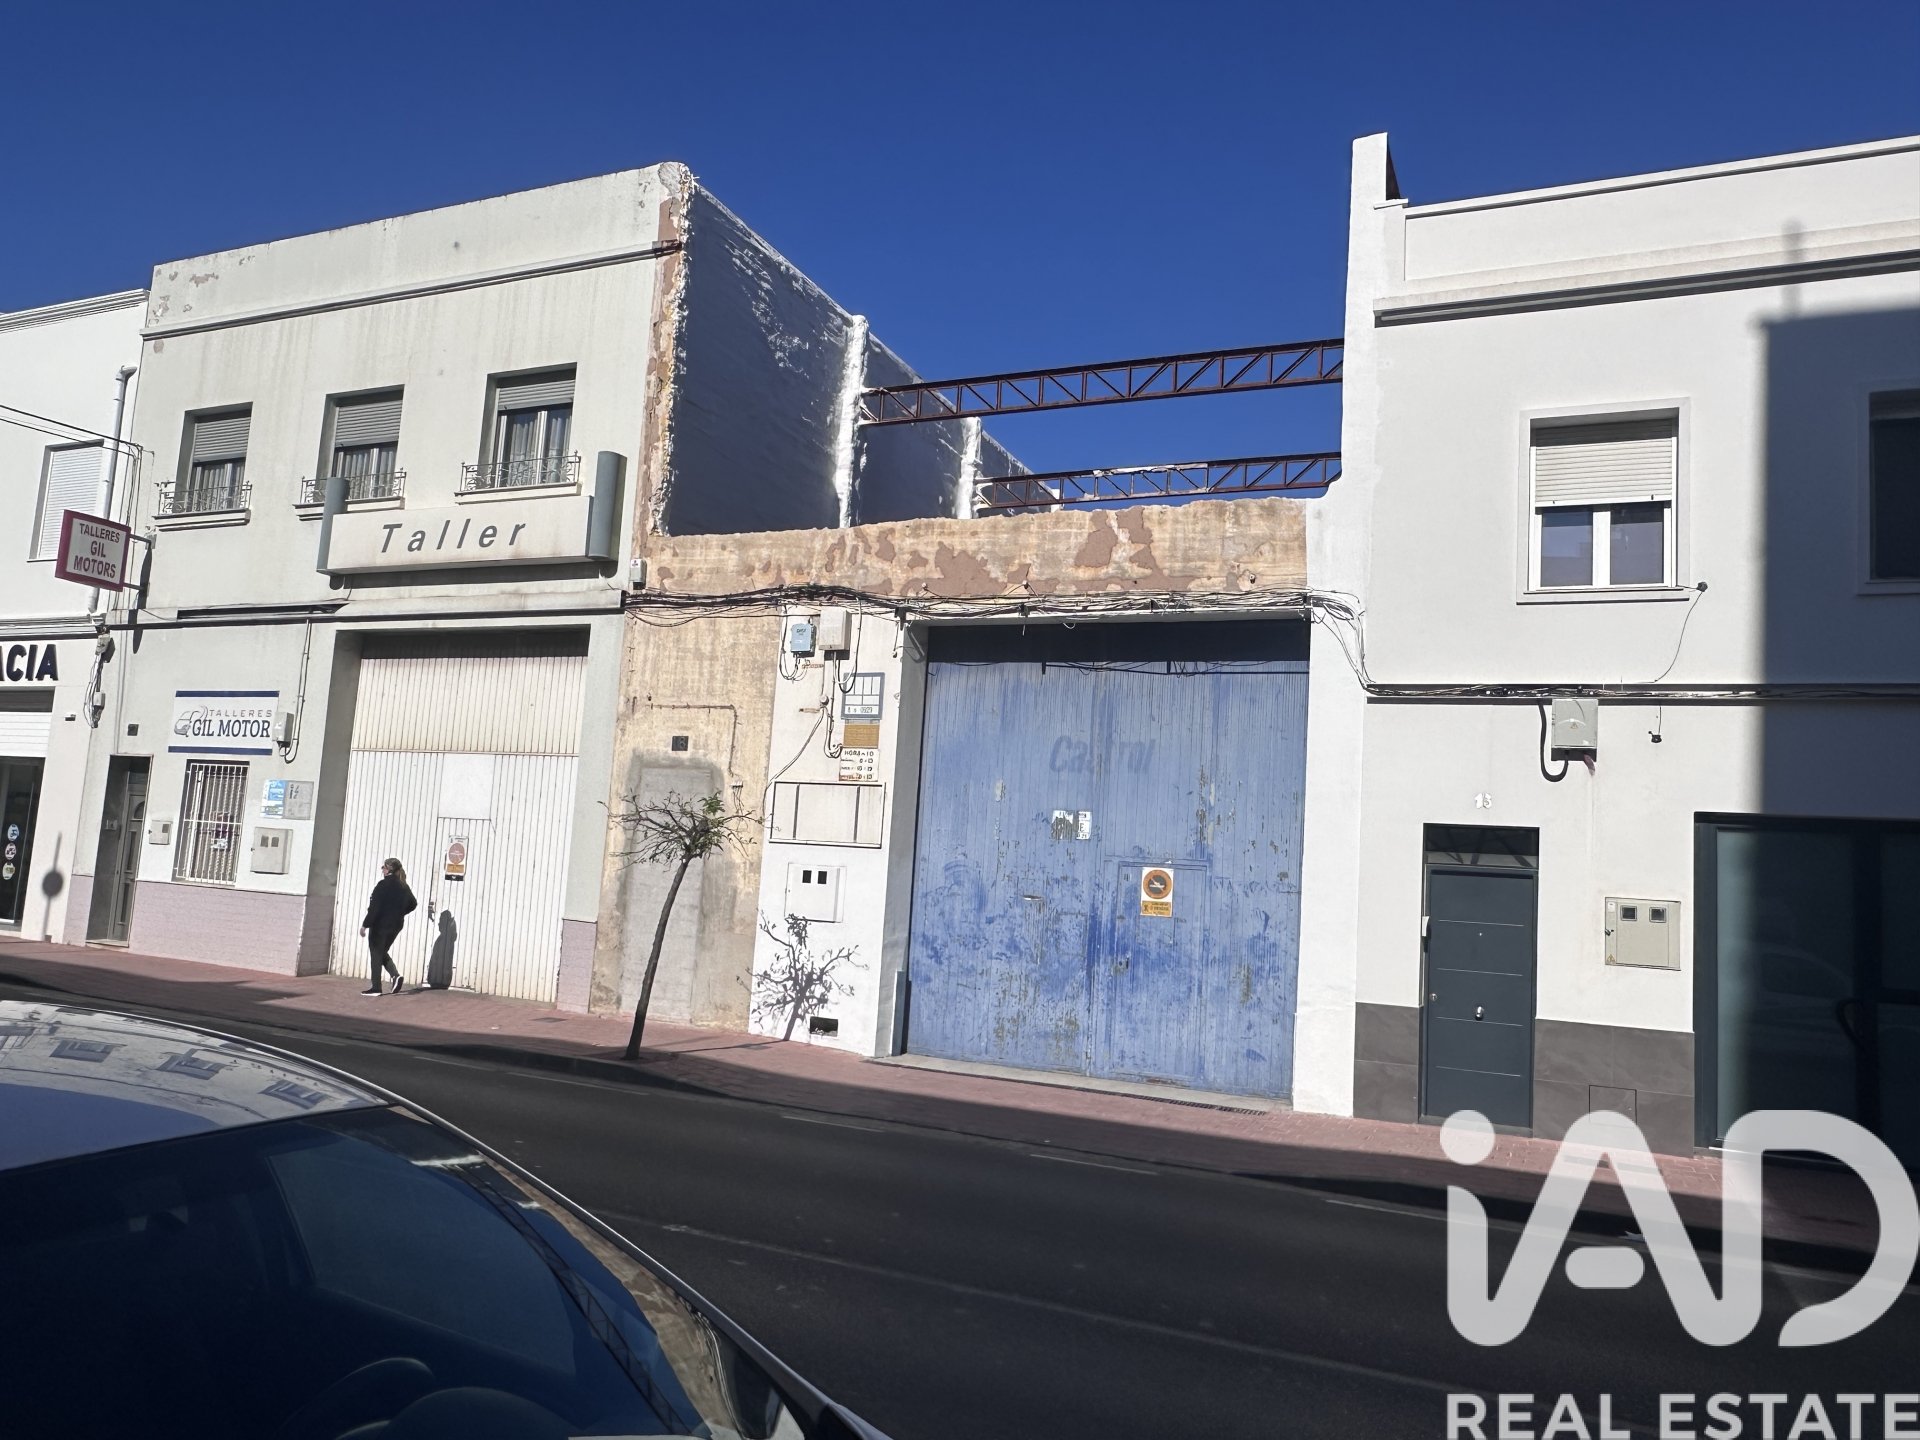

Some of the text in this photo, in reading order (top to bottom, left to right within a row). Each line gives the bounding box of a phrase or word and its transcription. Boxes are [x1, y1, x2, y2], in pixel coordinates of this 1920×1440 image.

[79, 522, 121, 544] TALLERES
[381, 518, 527, 553] Taller
[90, 540, 107, 558] GIL
[73, 555, 117, 579] MOTORS
[209, 709, 273, 718] TALLERES
[192, 718, 271, 738] GIL MOTOR
